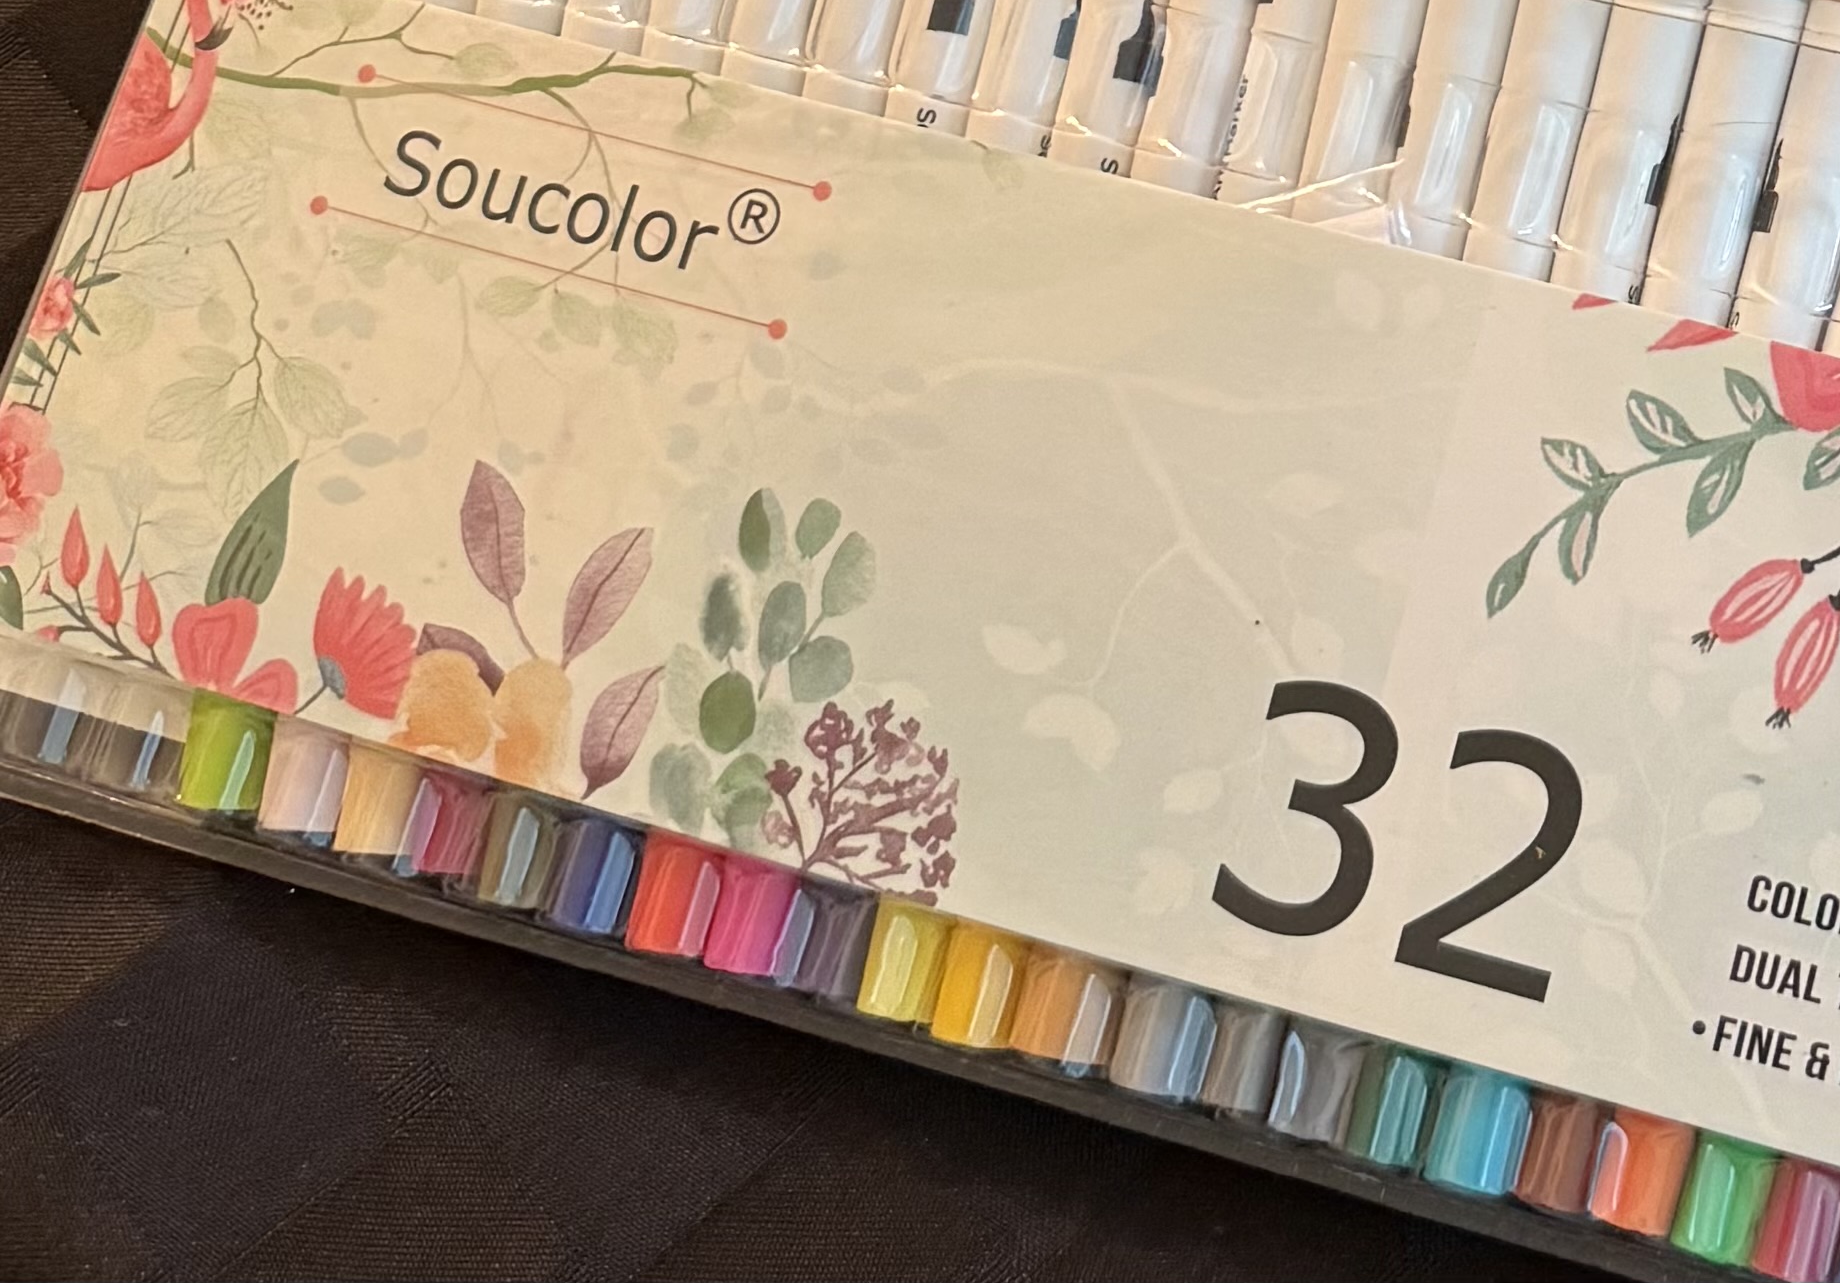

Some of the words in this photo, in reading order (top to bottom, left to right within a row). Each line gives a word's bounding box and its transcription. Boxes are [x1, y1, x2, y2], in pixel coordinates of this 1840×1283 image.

[1210, 677, 1585, 1004] 32
[1728, 943, 1822, 1005] DUAL
[1712, 1014, 1798, 1073] FINE
[1804, 1041, 1832, 1081] &
